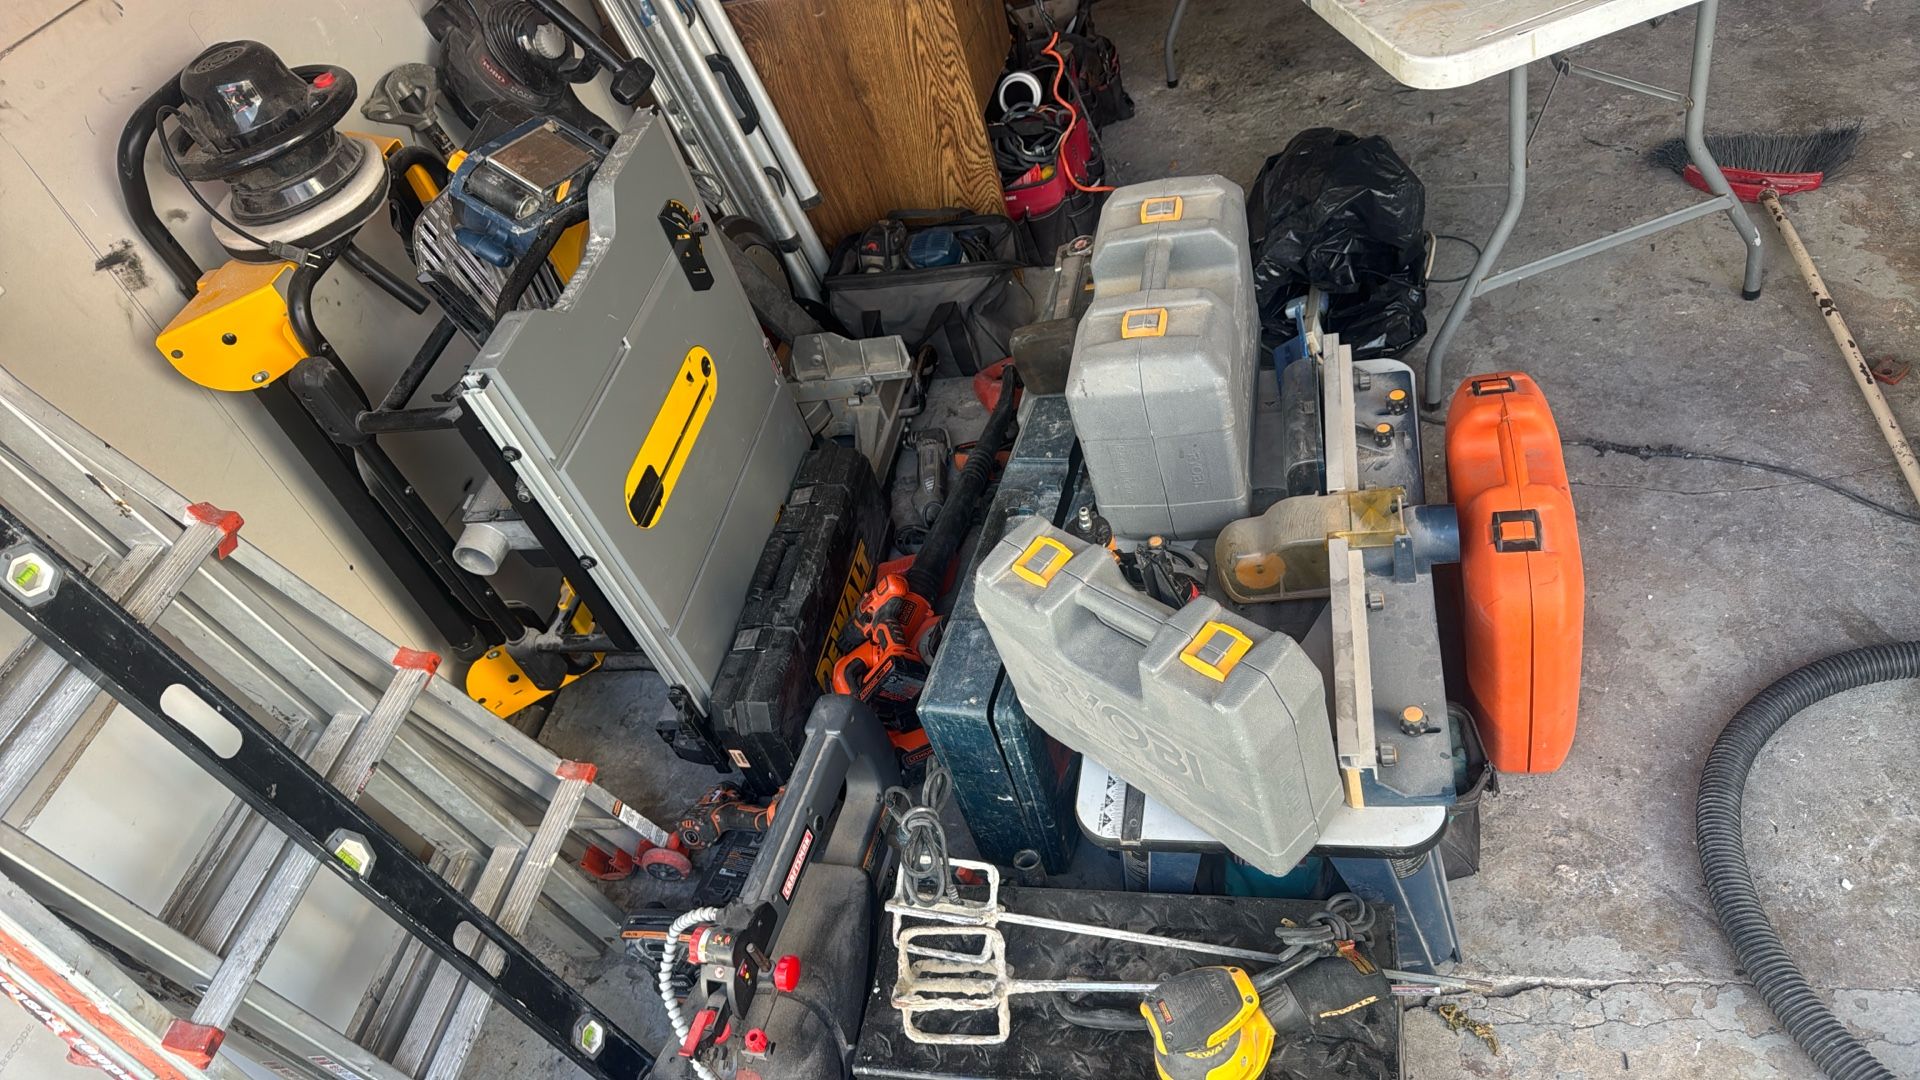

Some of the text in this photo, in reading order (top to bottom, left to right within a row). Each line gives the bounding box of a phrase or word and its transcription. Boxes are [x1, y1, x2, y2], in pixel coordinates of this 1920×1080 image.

[482, 58, 506, 84] TORO
[1045, 671, 1212, 793] RYOBI
[783, 834, 811, 899] CRAFTSMAN
